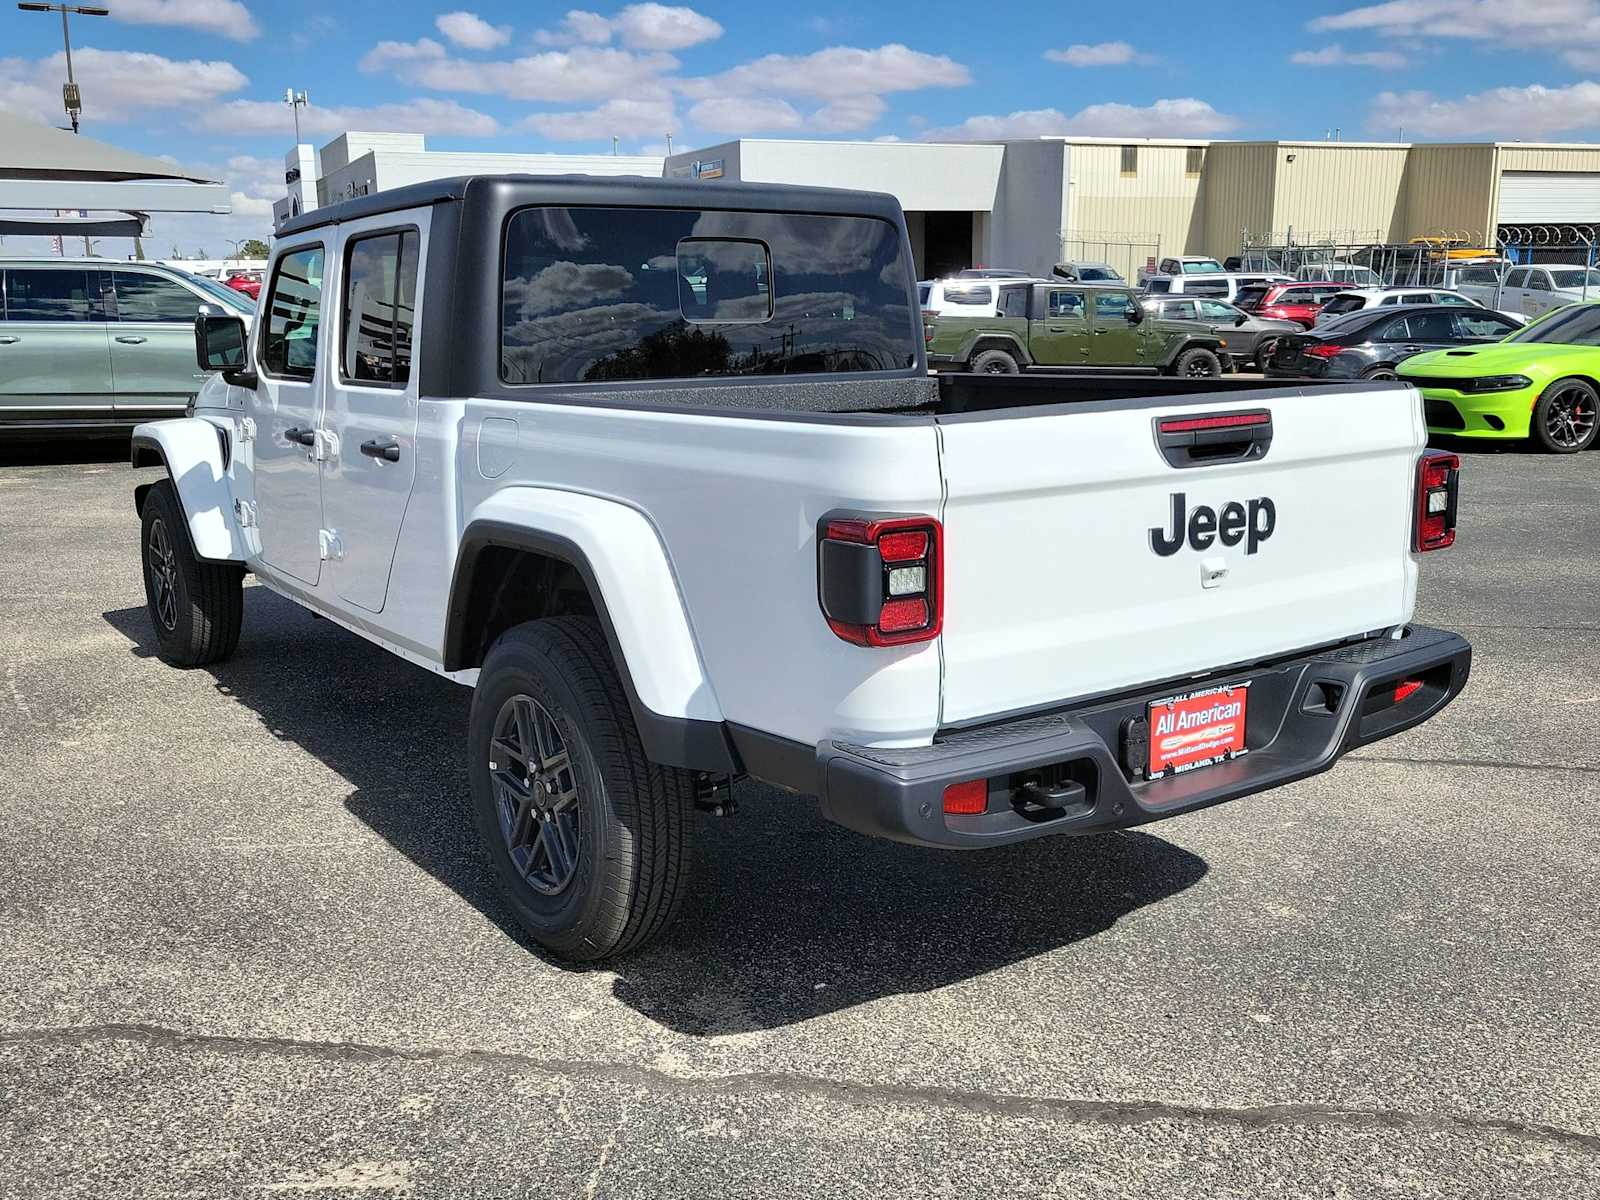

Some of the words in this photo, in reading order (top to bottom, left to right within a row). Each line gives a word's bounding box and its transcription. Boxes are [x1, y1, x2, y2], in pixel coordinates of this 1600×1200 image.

[1148, 492, 1276, 557] Jeep
[1174, 695, 1188, 704] ALL
[1155, 713, 1175, 736] All
[1176, 702, 1241, 731] American
[1214, 754, 1225, 763] TX
